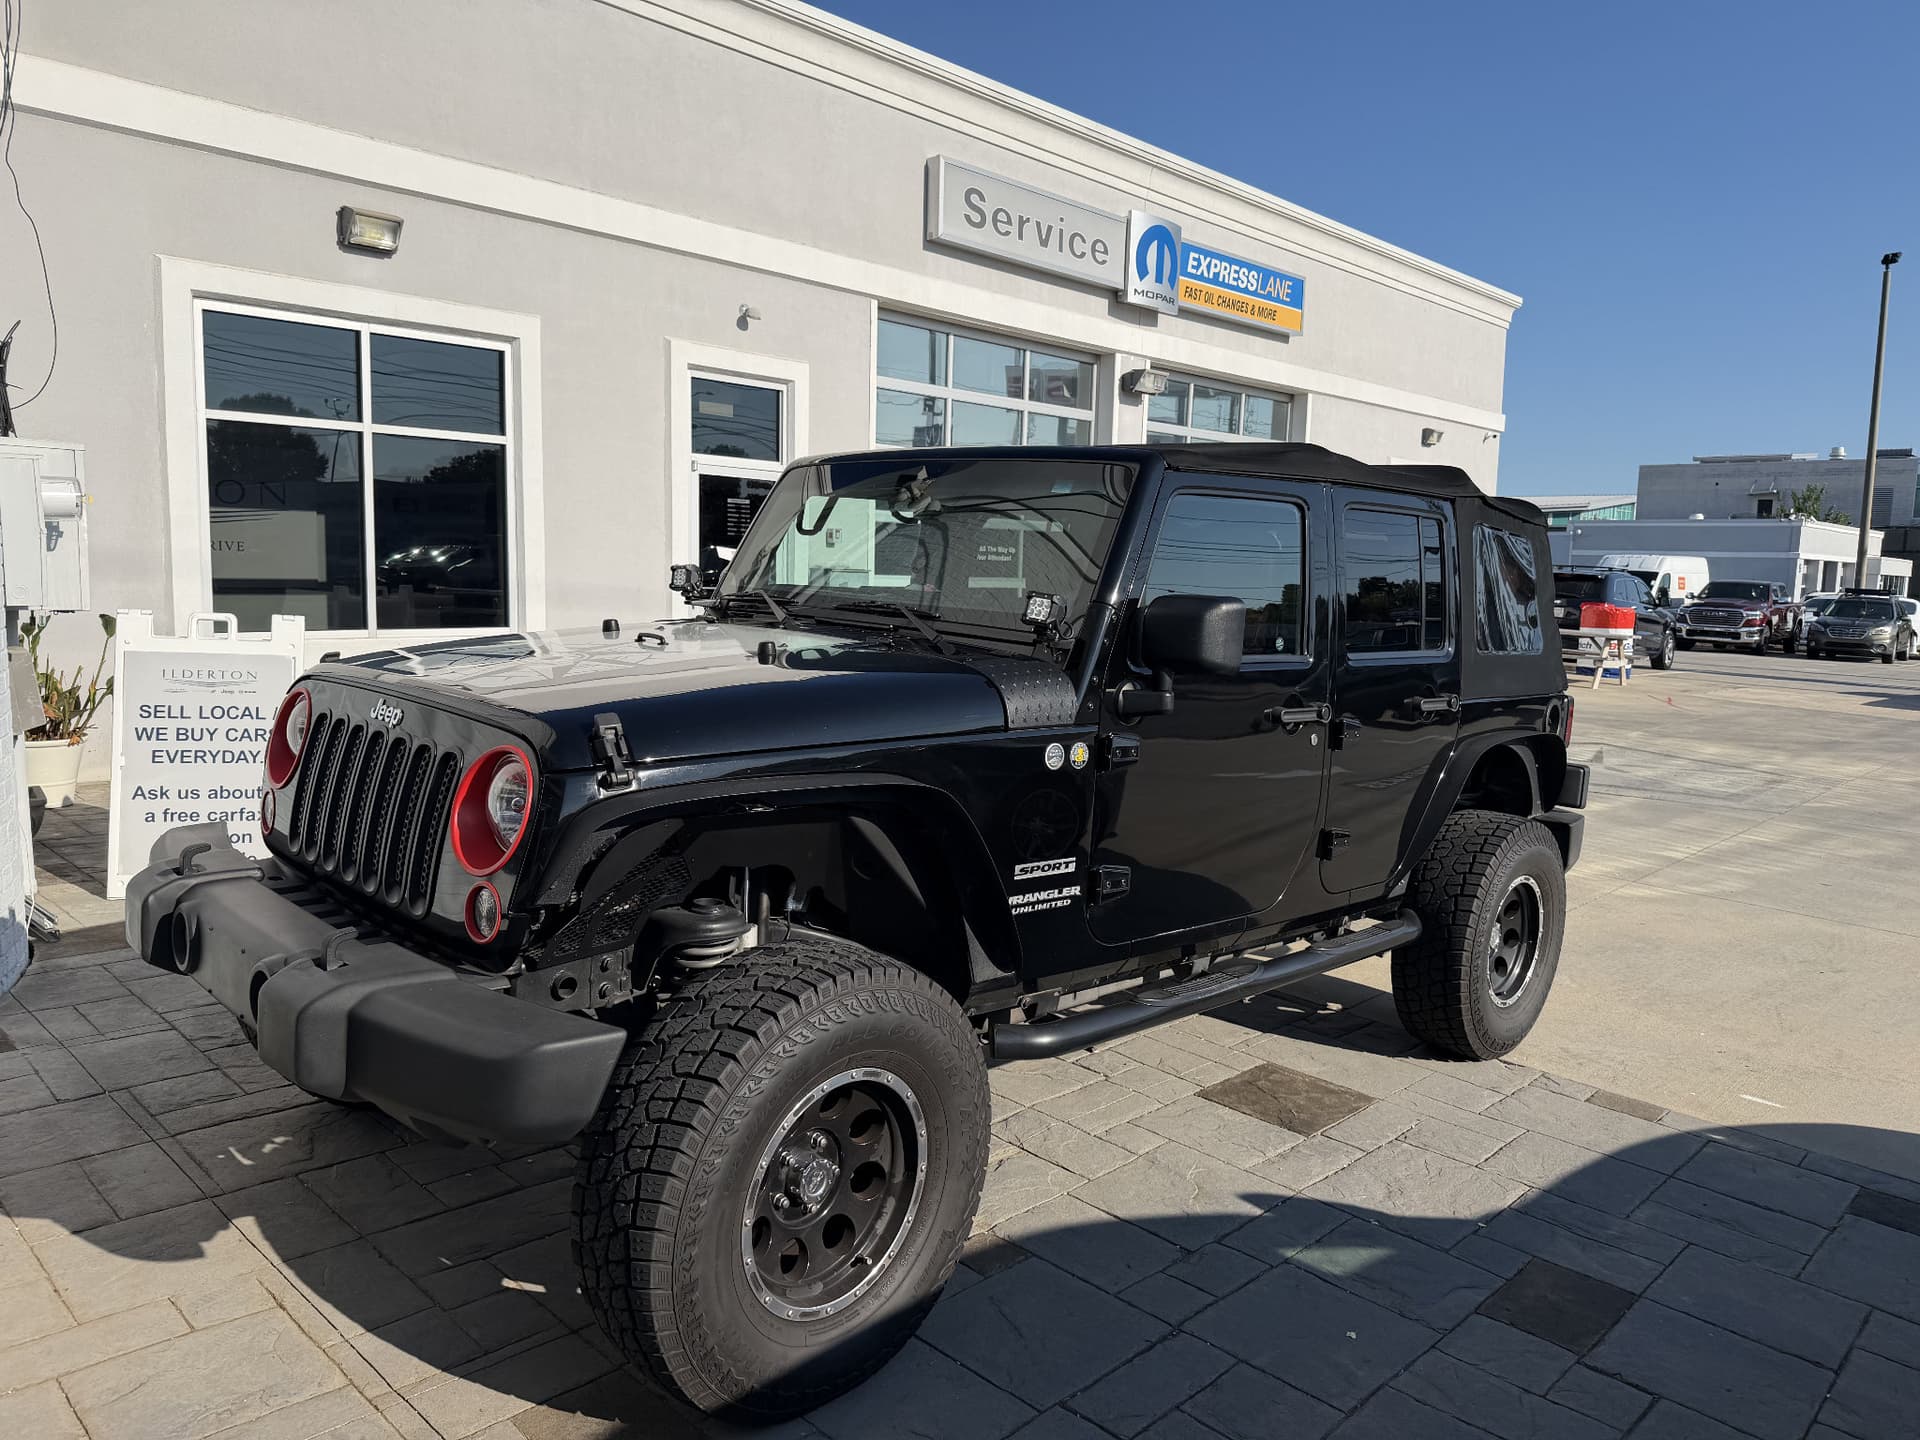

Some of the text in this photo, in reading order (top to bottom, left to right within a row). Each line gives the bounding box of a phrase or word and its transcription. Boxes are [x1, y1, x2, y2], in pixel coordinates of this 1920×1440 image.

[963, 187, 1110, 267] Service
[1133, 288, 1176, 306] MOPAR
[1183, 285, 1278, 321] FAST OIL CHANGES & MORE
[162, 669, 258, 680] ILDERTON
[139, 704, 191, 719] SELL
[199, 705, 266, 720] LOCAL
[370, 698, 404, 728] Jeep
[135, 727, 169, 742] WE
[176, 727, 217, 742] BUY
[151, 749, 263, 764] EVERYDAY.
[132, 785, 263, 800] Ask us about
[145, 813, 156, 823] a
[163, 808, 200, 823] free
[1017, 860, 1075, 876] SPORT
[1012, 899, 1071, 915] UNLIMITED
